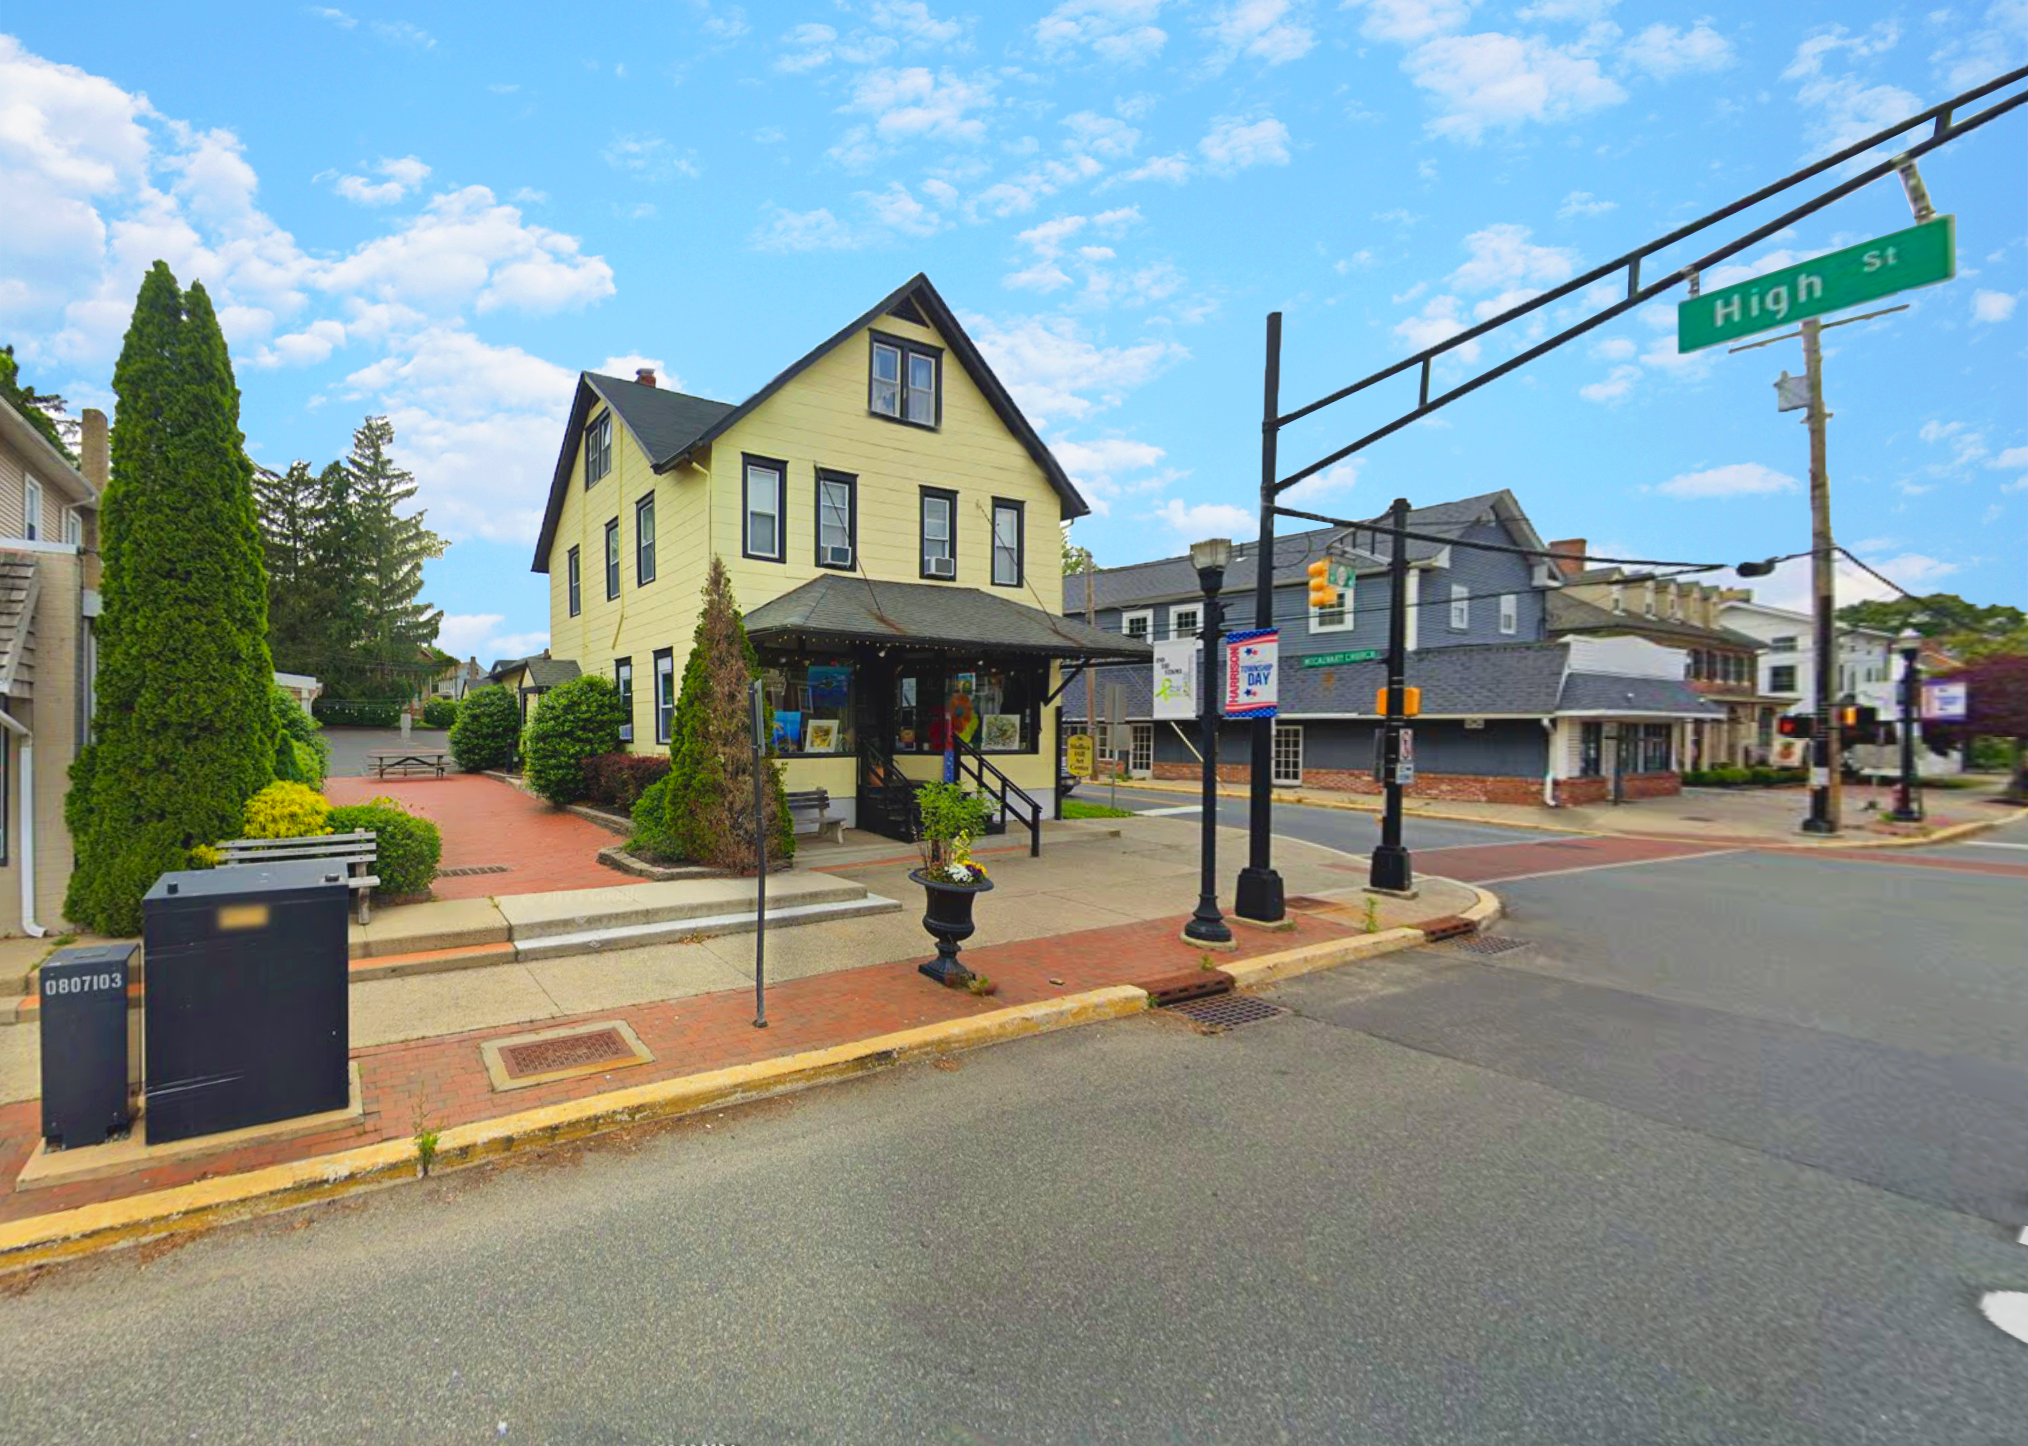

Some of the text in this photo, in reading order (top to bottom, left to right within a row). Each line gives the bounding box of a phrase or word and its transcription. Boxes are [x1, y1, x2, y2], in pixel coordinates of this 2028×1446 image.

[1713, 245, 1899, 328] High St
[1229, 647, 1240, 704] HARRISON
[1241, 663, 1273, 674] TOWNSHIP
[1247, 672, 1271, 686] DAY
[45, 973, 122, 996] 0807103
